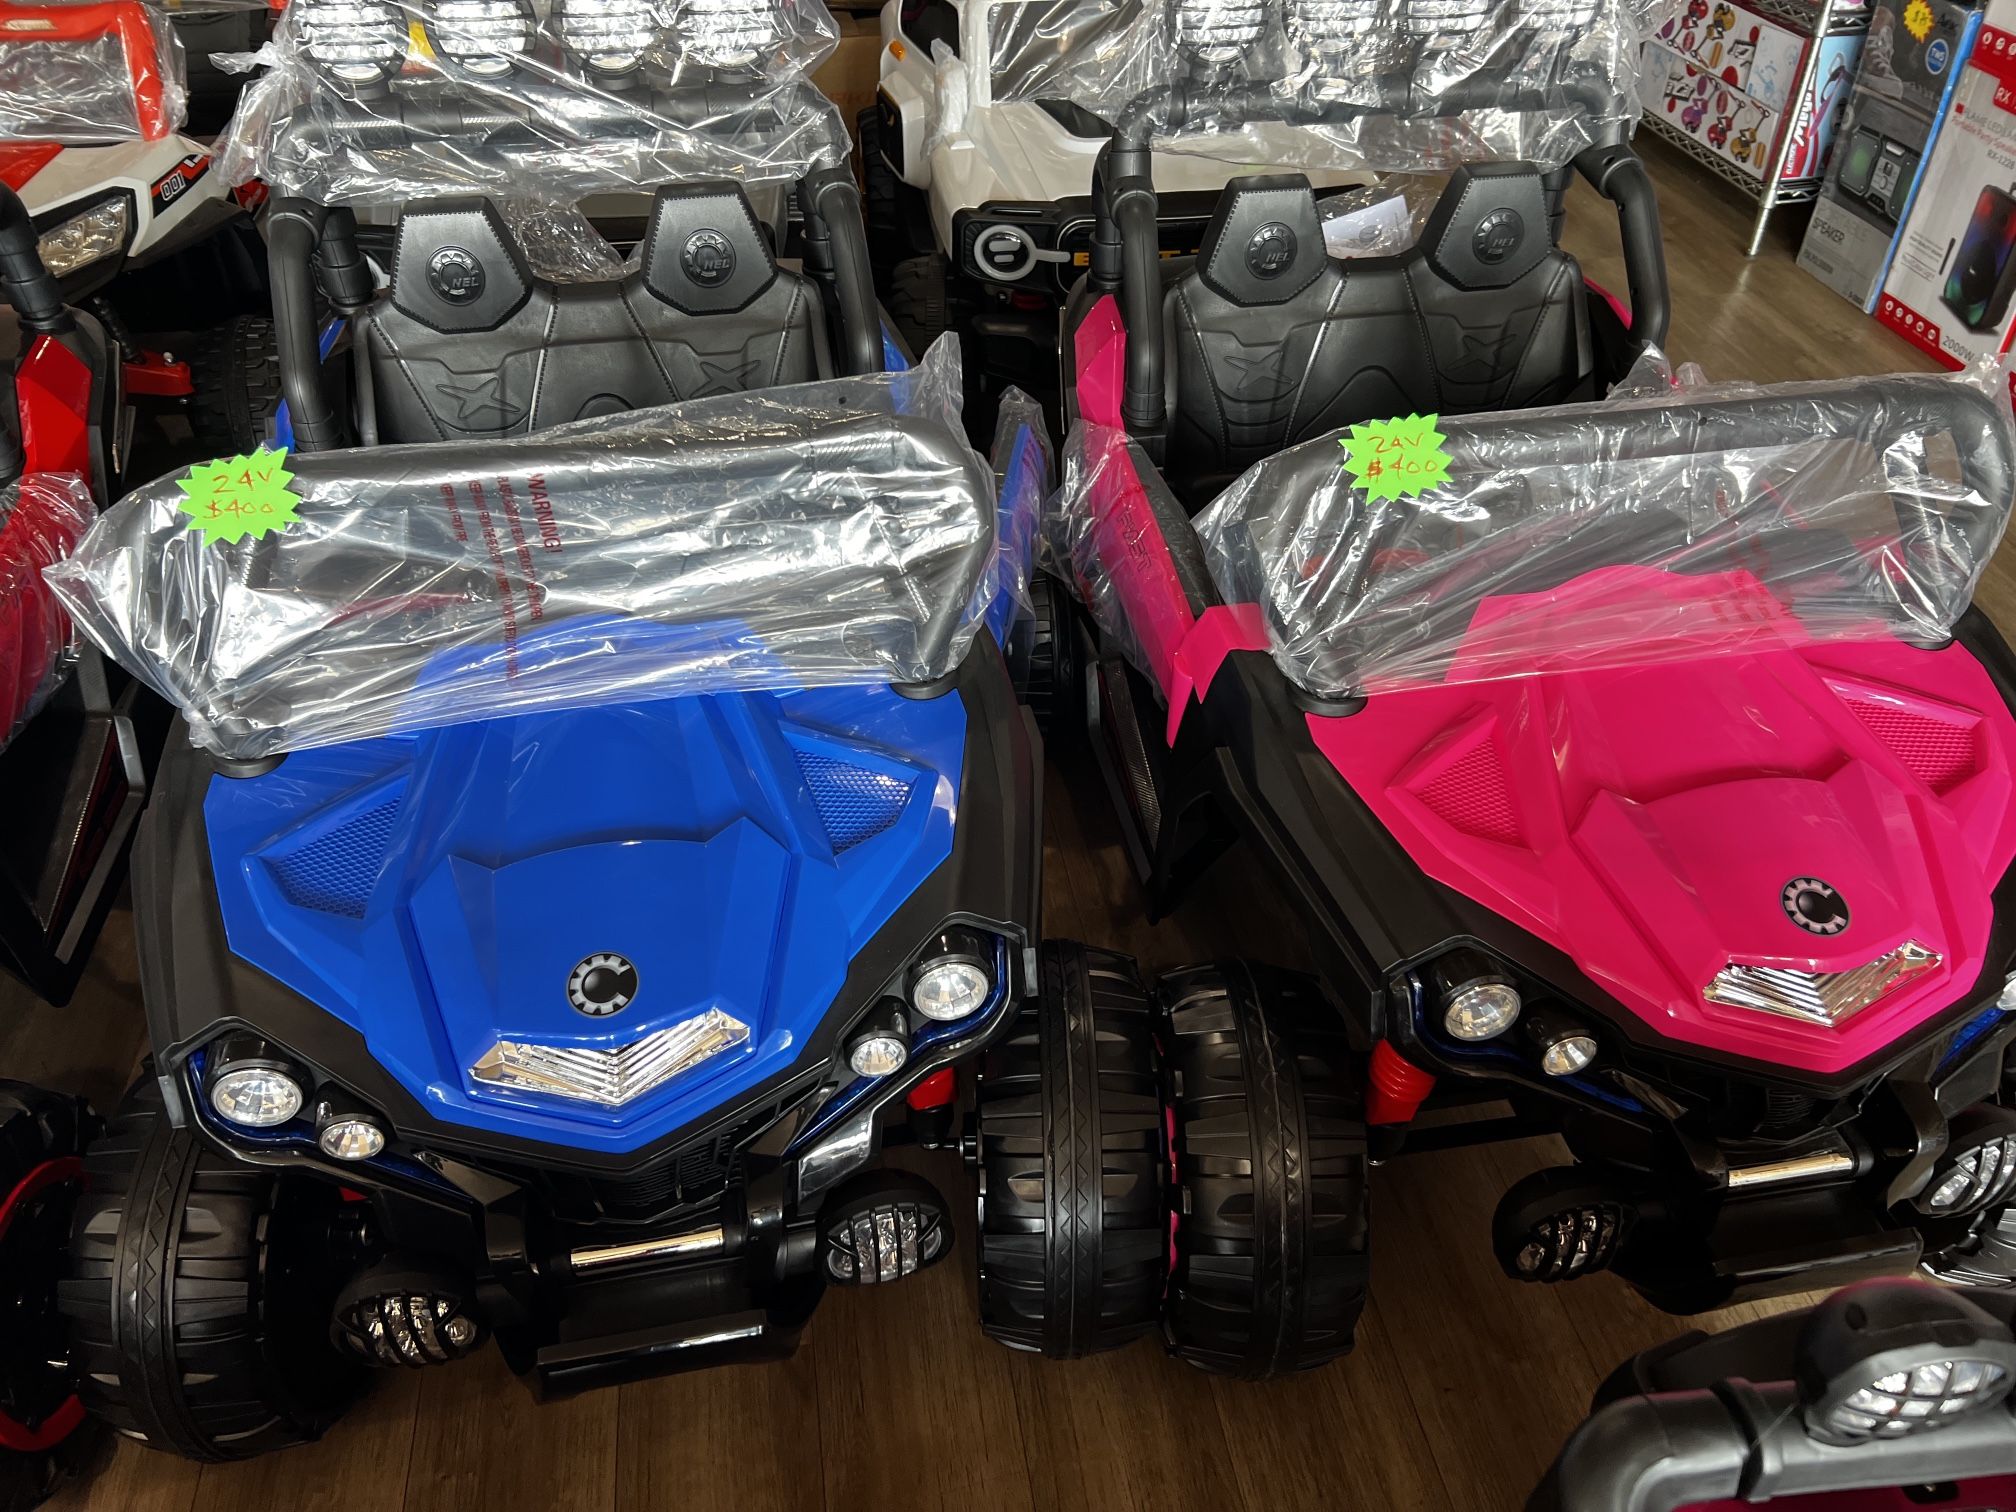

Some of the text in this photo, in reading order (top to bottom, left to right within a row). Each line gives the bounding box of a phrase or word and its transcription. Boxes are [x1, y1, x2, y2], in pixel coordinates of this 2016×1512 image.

[1812, 217, 1845, 244] SPEAKER
[1943, 335, 1975, 362] 2000W
[1365, 453, 1438, 483] $400
[202, 498, 274, 520] $400
[527, 473, 563, 553] WARNING!
